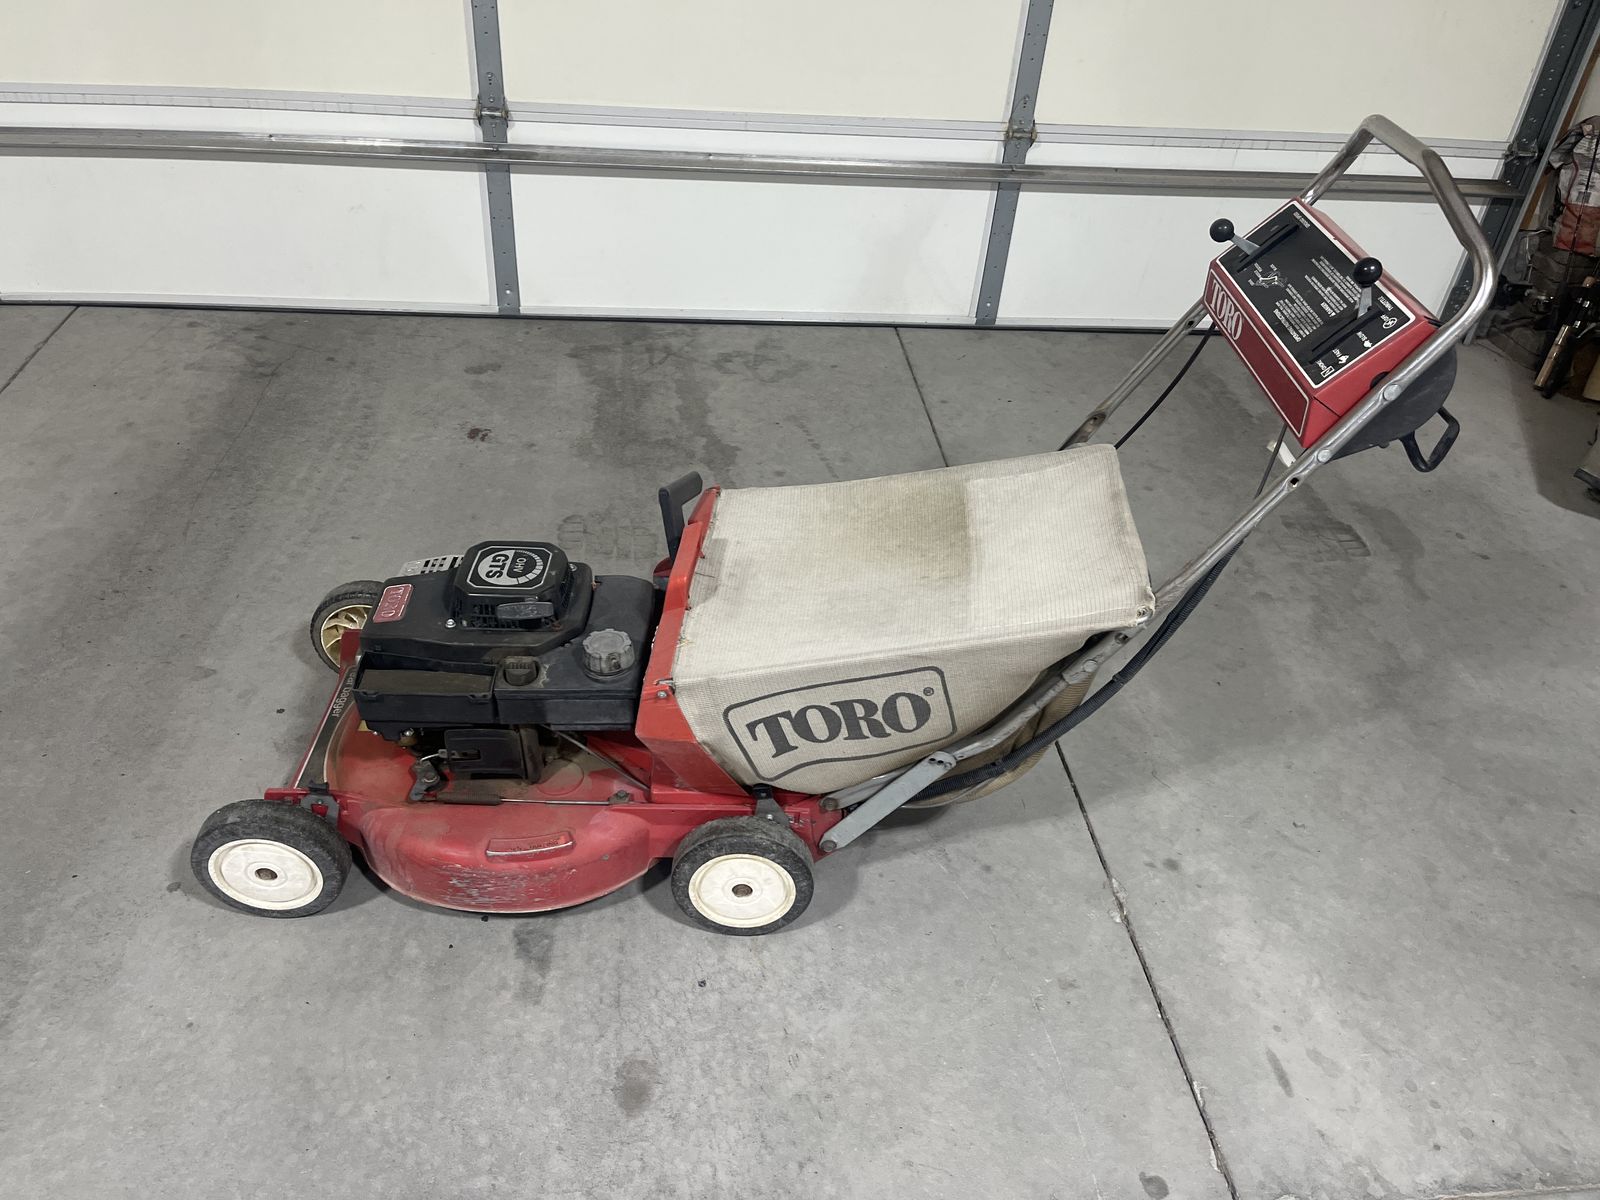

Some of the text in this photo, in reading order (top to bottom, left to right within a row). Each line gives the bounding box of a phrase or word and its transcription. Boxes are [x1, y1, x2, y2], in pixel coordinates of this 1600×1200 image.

[1210, 279, 1243, 341] TORO
[1380, 313, 1390, 322] OFF
[1356, 330, 1368, 342] SLOW
[1331, 348, 1343, 358] FAST
[485, 553, 510, 579] GTS
[513, 557, 527, 573] OHV
[381, 587, 405, 618] TORO
